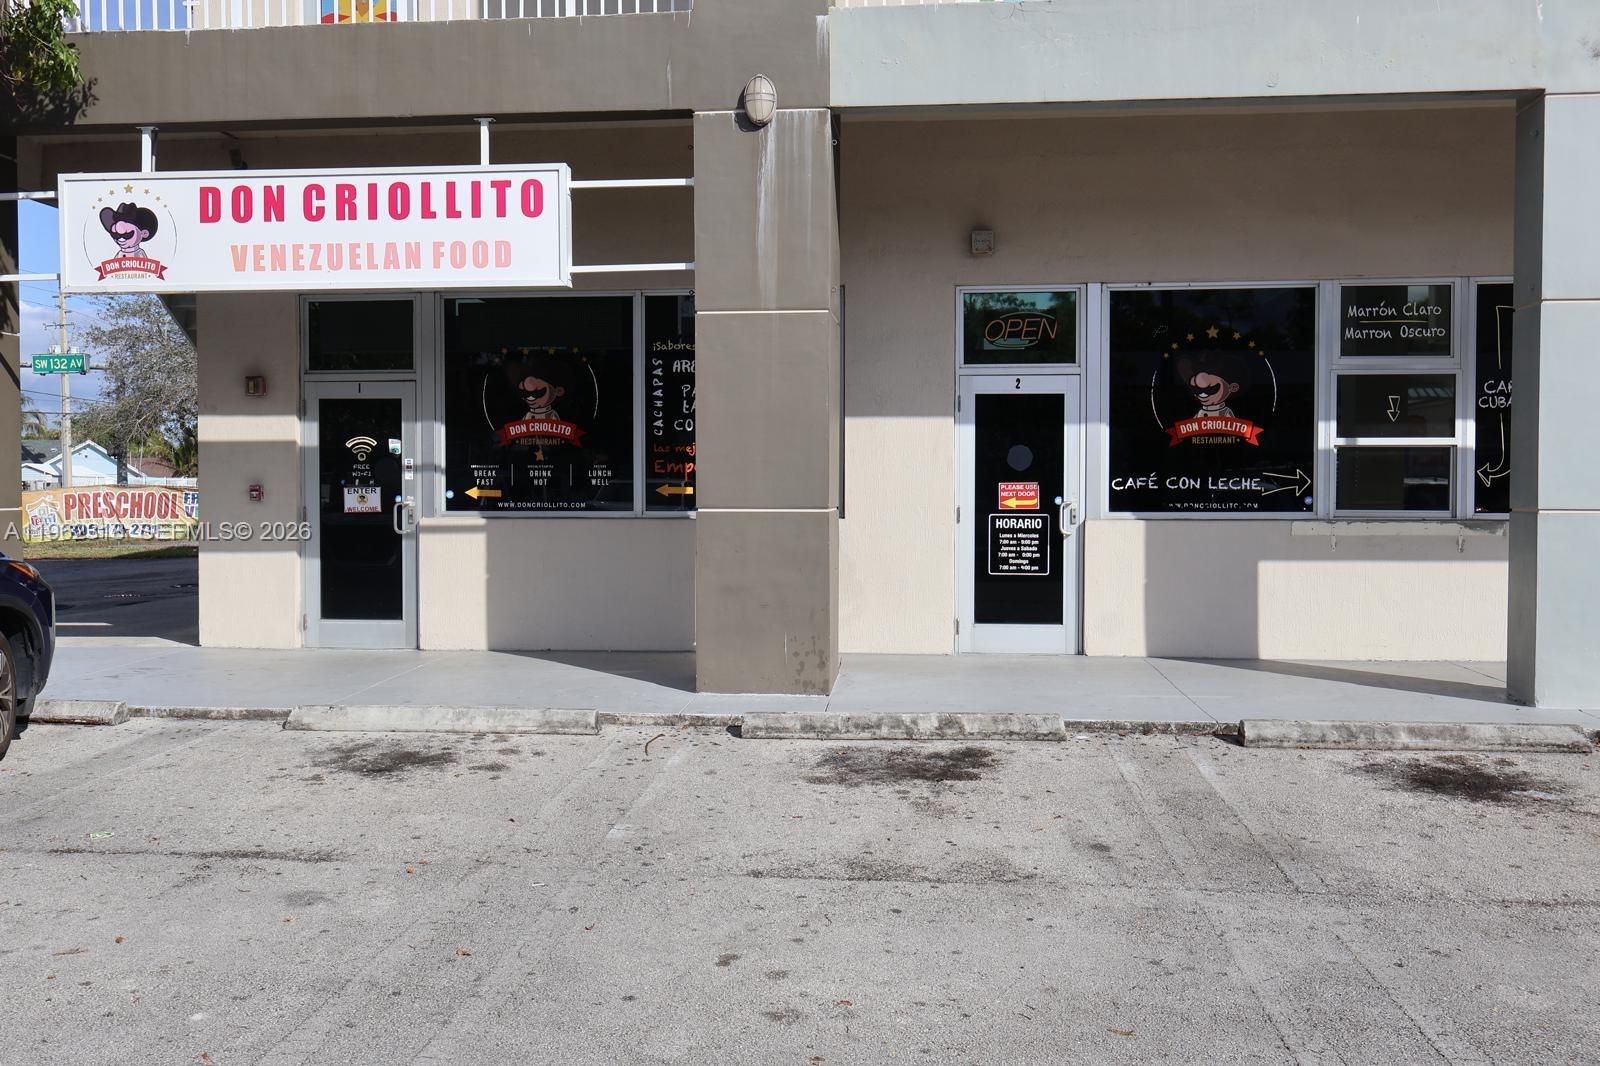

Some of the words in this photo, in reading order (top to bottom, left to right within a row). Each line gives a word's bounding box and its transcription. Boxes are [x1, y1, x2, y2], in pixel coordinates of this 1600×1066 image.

[199, 184, 285, 224] DON
[302, 178, 544, 222] CRIOLLITO
[230, 240, 422, 273] VENEZUELAN
[432, 239, 512, 270] FOOD
[105, 261, 120, 272] DON
[121, 259, 156, 271] CRIOLLITO
[114, 272, 148, 280] RESTAURANT
[1347, 301, 1398, 318] Marrón
[1402, 302, 1442, 317] Claro
[985, 318, 1058, 341] OPEN
[1344, 326, 1393, 340] Marron
[1400, 325, 1446, 338] Oscuro
[35, 359, 48, 369] SW
[50, 358, 68, 370] 132
[70, 358, 83, 369] AV
[1015, 378, 1021, 389] 2
[652, 357, 664, 436] CACHAPAS
[509, 423, 527, 435] DON
[529, 422, 571, 436] CRIOLLITO
[1180, 423, 1199, 434] DON
[1201, 420, 1247, 433] CRIOLLITO
[520, 438, 561, 446] RESTAURANT
[1191, 436, 1236, 444] RESTAURANT
[655, 460, 696, 481] Emp
[476, 478, 494, 486] FAST
[1111, 471, 1159, 491] CAFÉ
[1166, 476, 1201, 490] CON
[1208, 476, 1262, 490] LECHE
[347, 487, 377, 495] ENTER
[63, 491, 179, 521] PRESCHOOL
[995, 518, 1042, 529] HORARIO
